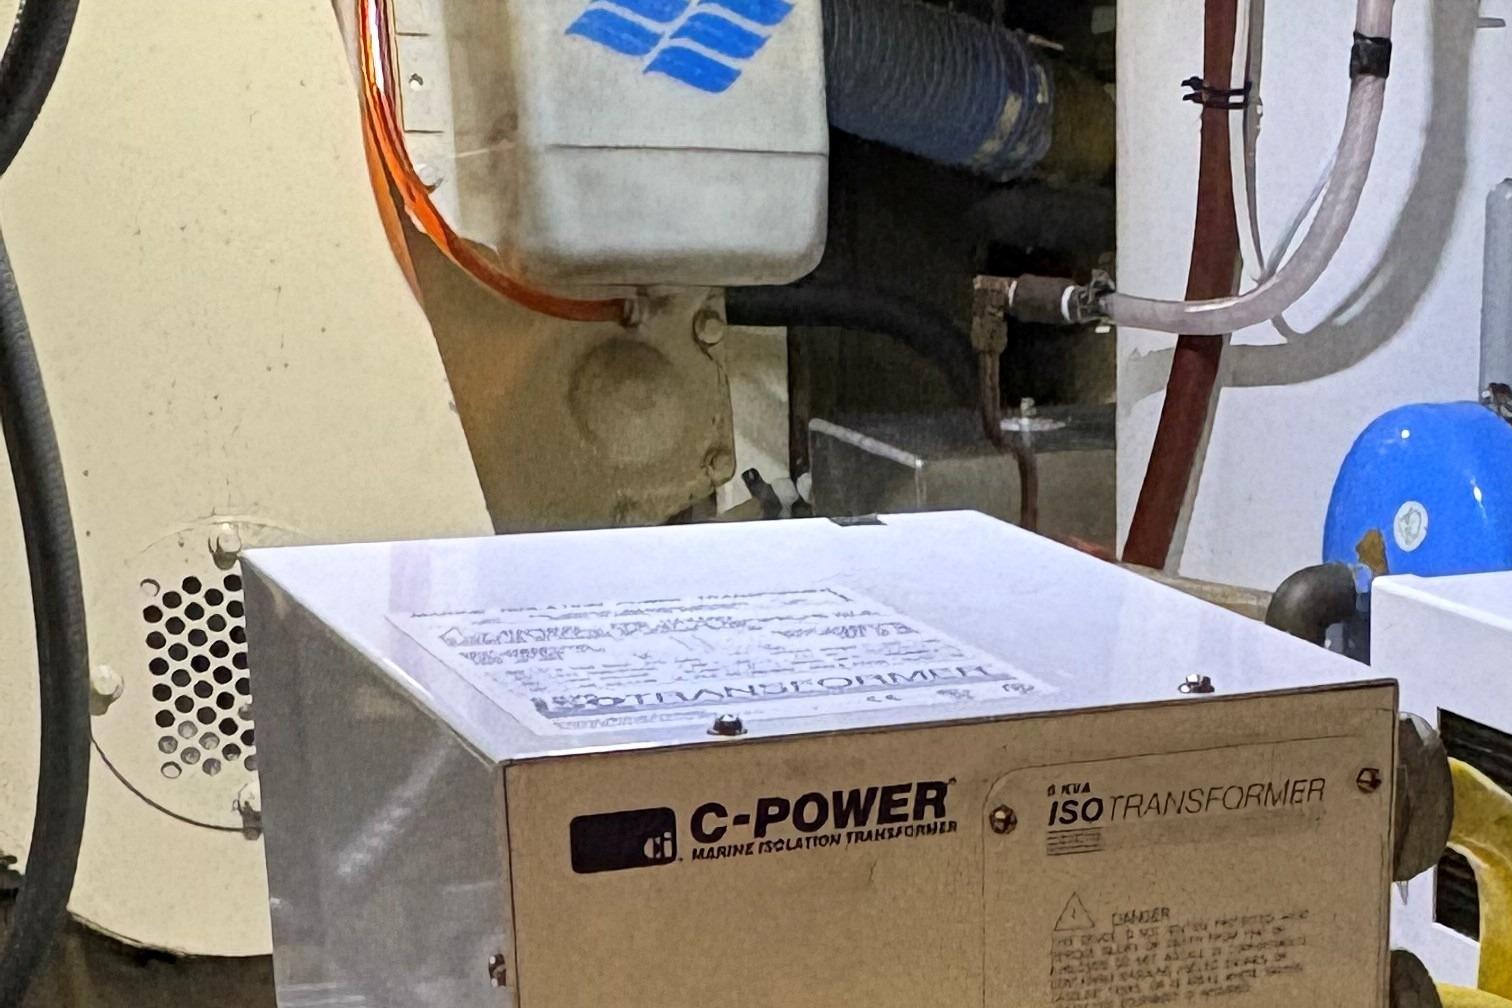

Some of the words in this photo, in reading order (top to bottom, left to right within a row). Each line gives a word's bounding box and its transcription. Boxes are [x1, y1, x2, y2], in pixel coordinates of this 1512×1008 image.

[692, 842, 753, 861] MARINE
[758, 833, 840, 855] ISOLATION
[846, 820, 958, 847] TRANSFORMER
